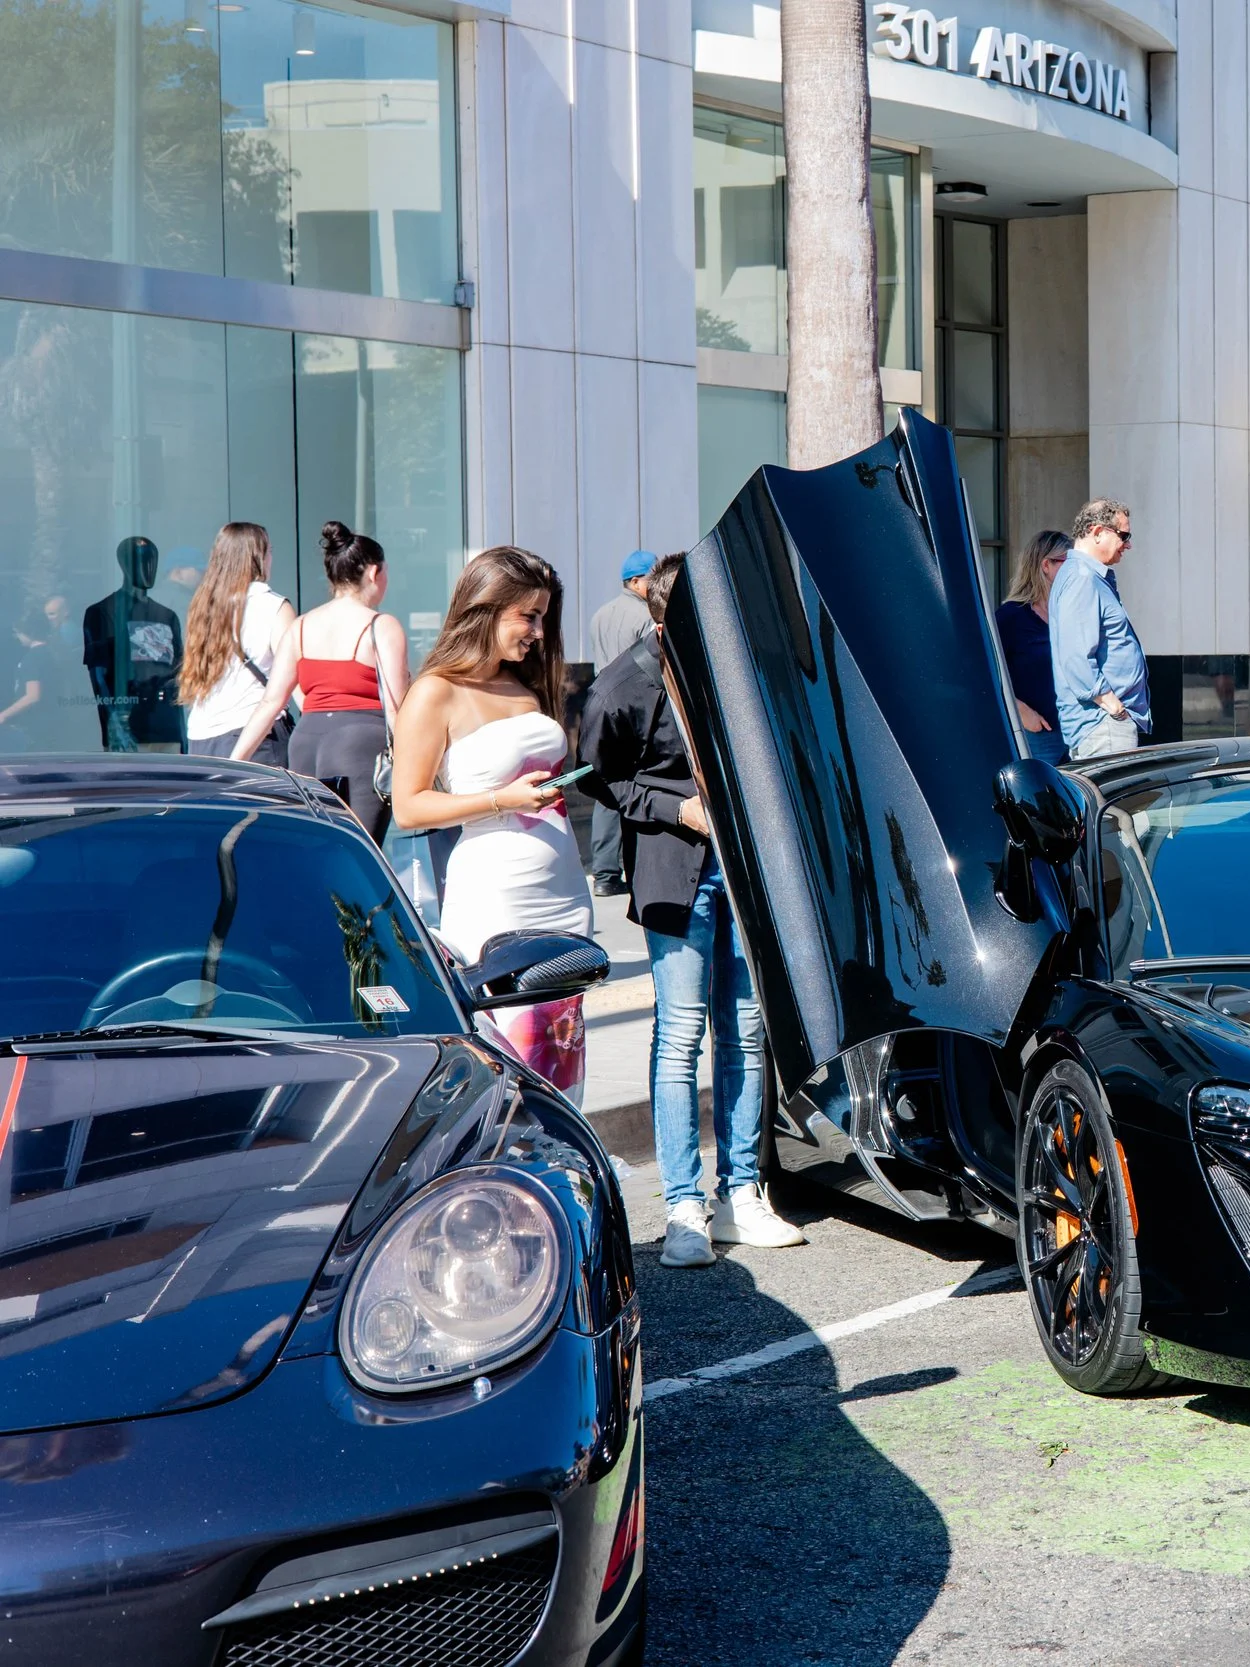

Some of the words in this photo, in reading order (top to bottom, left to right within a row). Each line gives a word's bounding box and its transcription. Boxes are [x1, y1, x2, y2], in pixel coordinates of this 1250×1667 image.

[872, 1, 959, 72] 301
[970, 26, 1131, 122] ARIZONA
[376, 997, 395, 1006] 16
